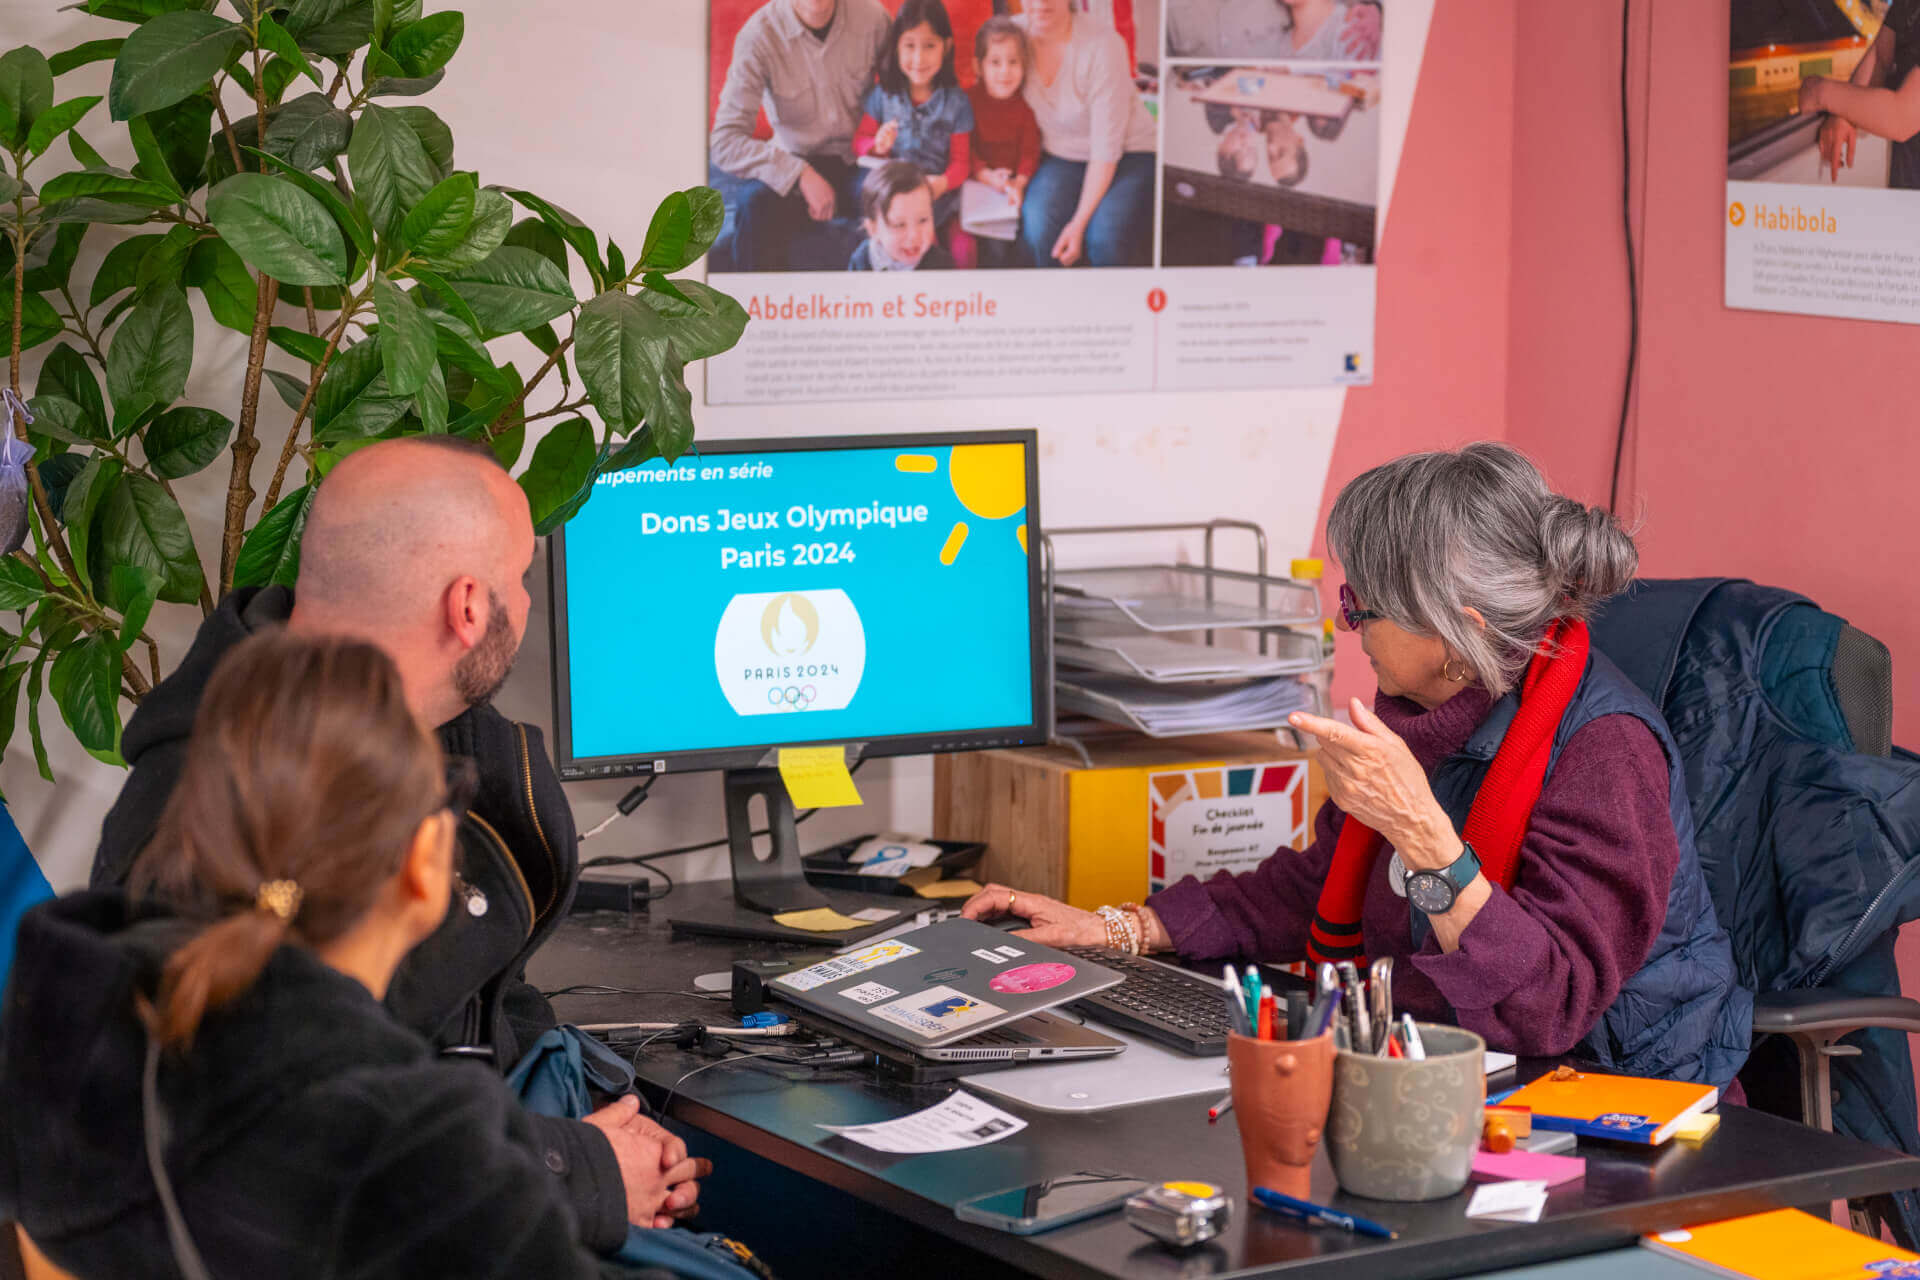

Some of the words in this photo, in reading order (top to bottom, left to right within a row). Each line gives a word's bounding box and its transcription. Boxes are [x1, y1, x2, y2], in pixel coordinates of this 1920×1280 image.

[1754, 204, 1837, 233] Habibola
[748, 293, 874, 320] Abdelkrim
[882, 294, 905, 319] et
[913, 290, 998, 323] Serpile
[700, 467, 724, 481] en
[728, 461, 774, 480] série
[641, 511, 711, 535] Dons
[716, 508, 779, 532] Jeux
[786, 500, 929, 532] Olympique
[720, 542, 786, 570] Paris
[791, 541, 857, 566] 2024
[744, 666, 791, 681] PARIS
[796, 663, 839, 678] 2024
